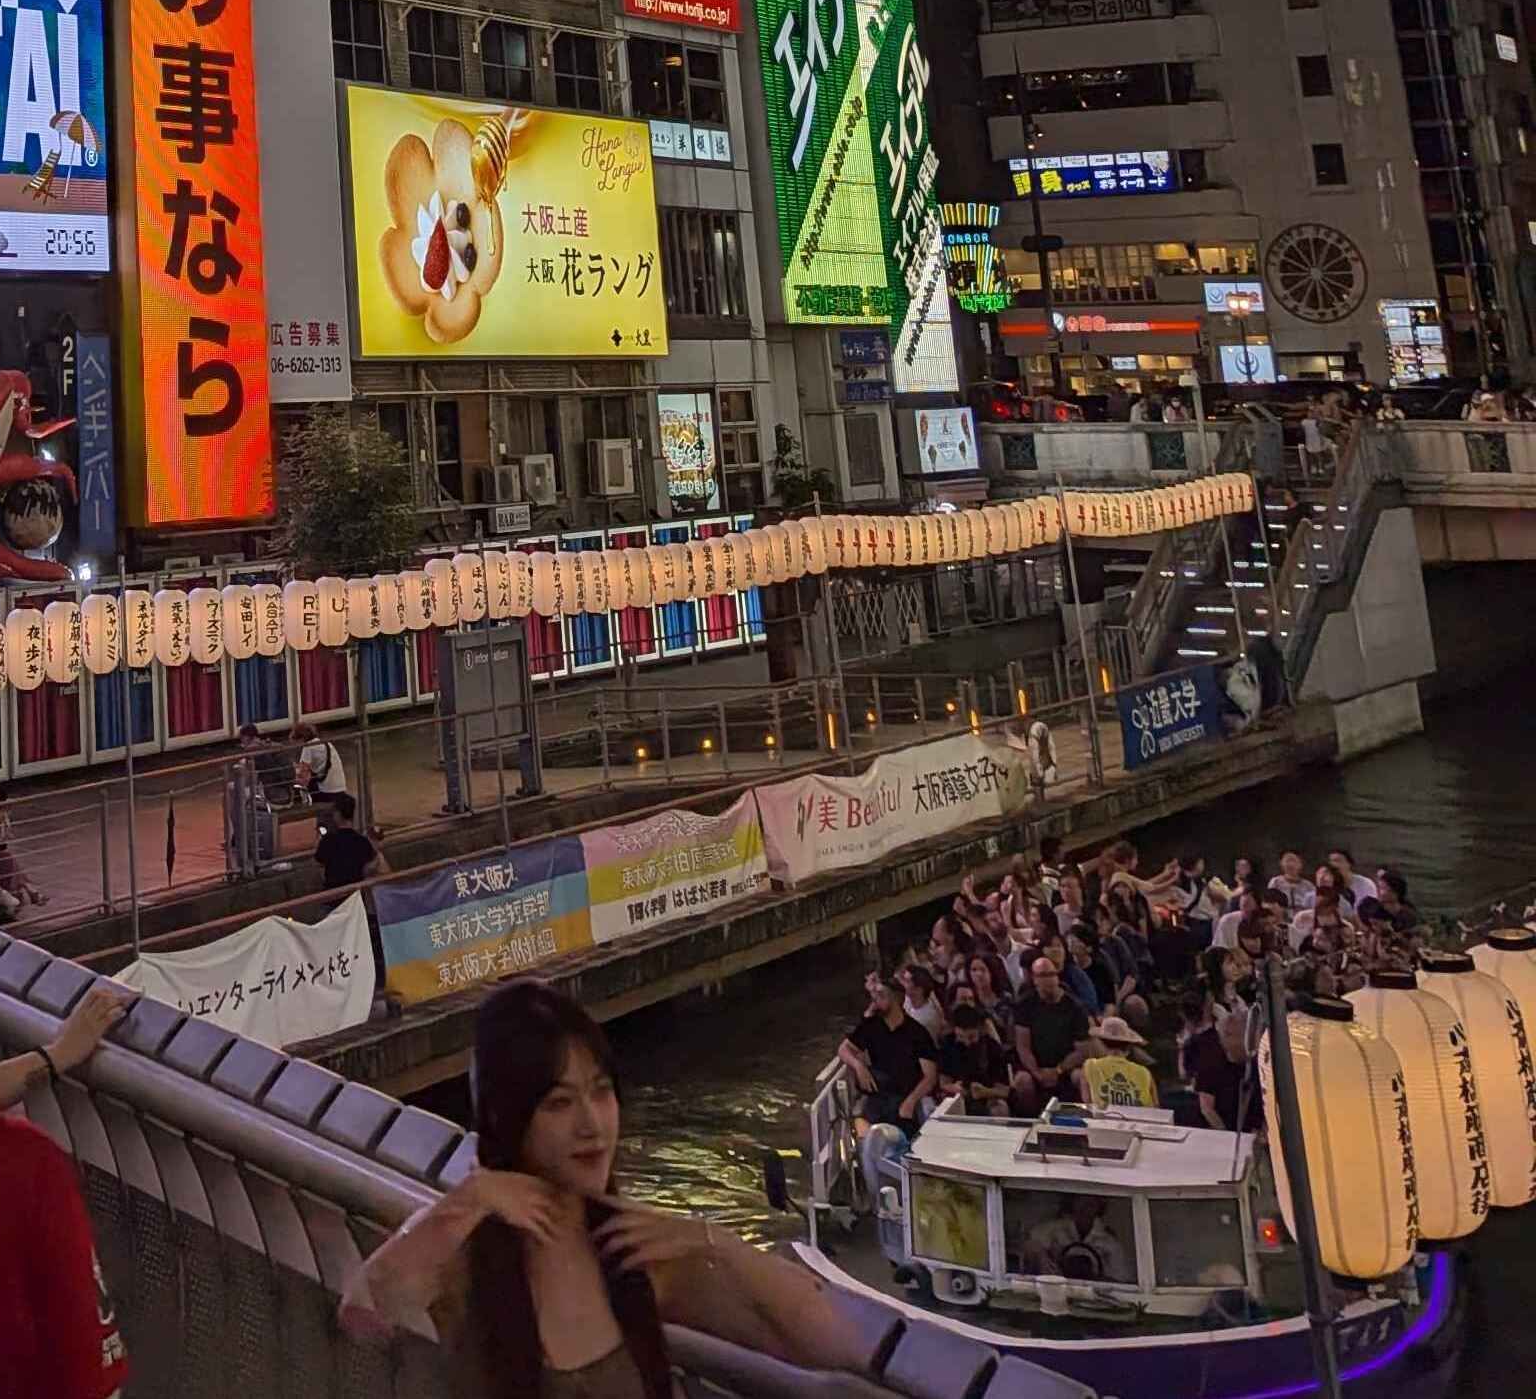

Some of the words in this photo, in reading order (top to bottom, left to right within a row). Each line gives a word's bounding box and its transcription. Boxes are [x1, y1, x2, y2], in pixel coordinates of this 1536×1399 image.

[521, 203, 590, 238] 大阪土産
[526, 257, 556, 284] 大阪
[559, 247, 654, 298] 花ラング
[270, 321, 340, 347] 広告募集
[61, 335, 75, 396] 2F
[270, 357, 342, 374] 06-6262-1313
[239, 596, 253, 647] 安田レイ
[265, 592, 280, 644] MASATO
[818, 795, 839, 834] 美
